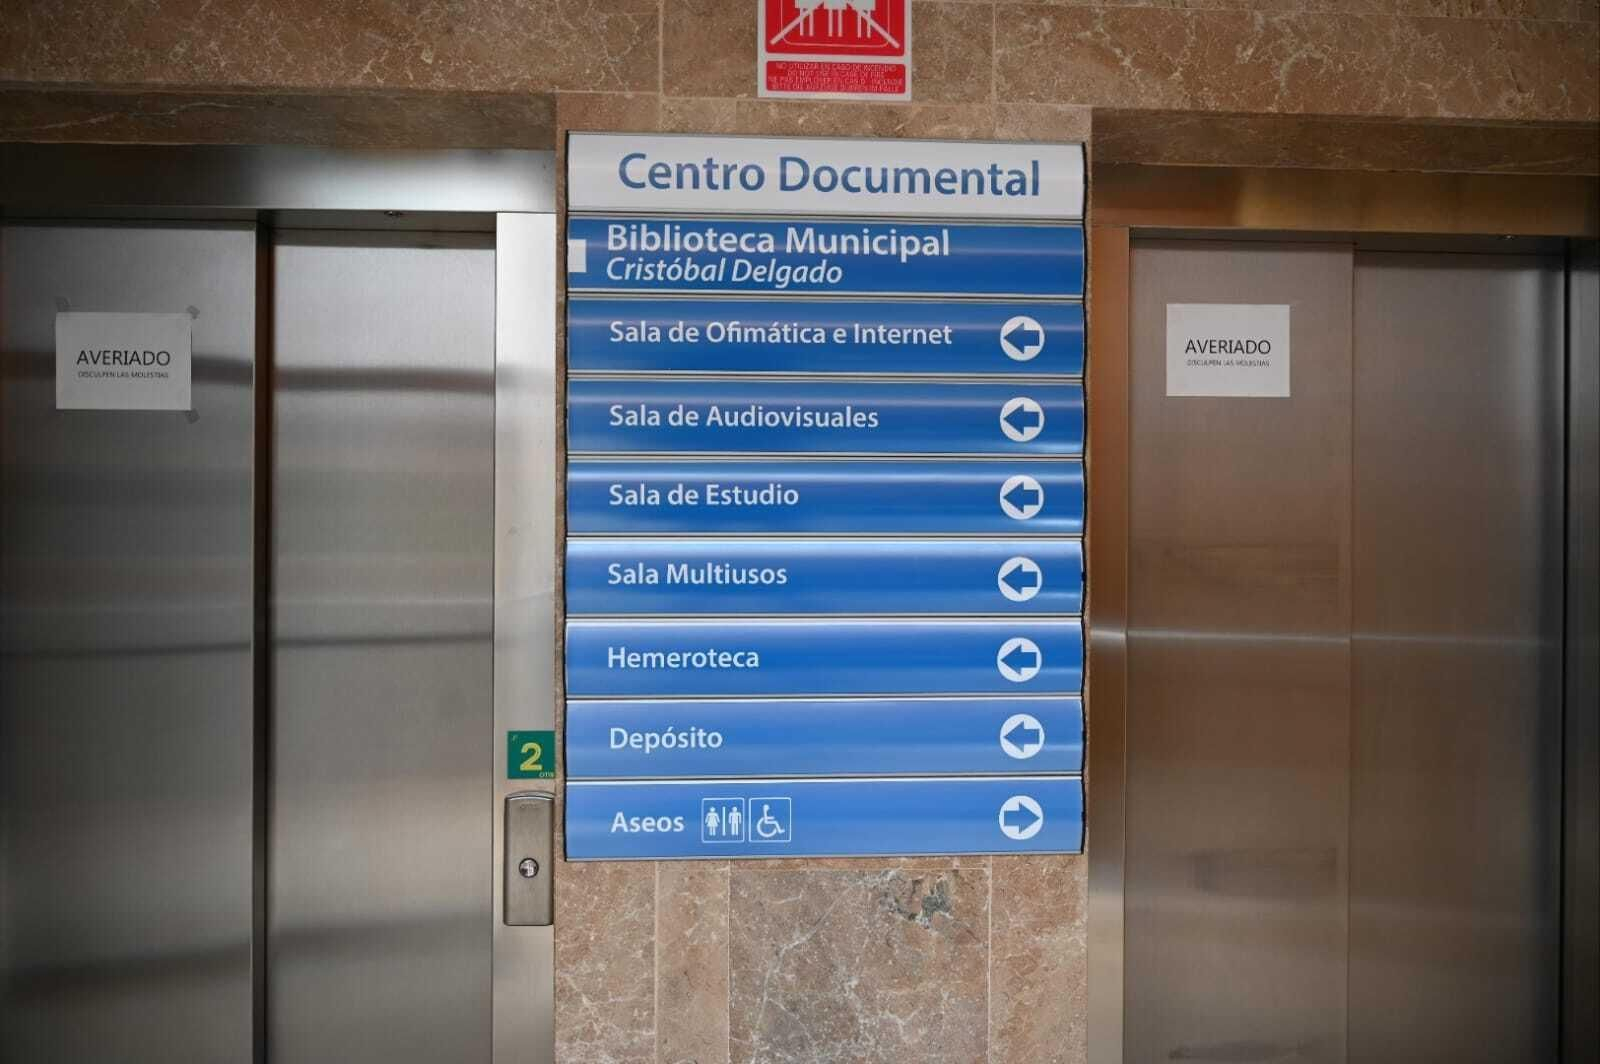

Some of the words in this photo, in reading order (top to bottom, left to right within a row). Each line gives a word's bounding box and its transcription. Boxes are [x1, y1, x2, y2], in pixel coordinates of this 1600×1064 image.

[619, 152, 765, 191] Centro
[779, 156, 1040, 197] Documental
[607, 224, 775, 255] Biblioteca
[786, 227, 949, 262] Municipal
[606, 256, 725, 284] Cristóbal
[731, 258, 843, 288] Delgado
[609, 320, 661, 343] Sala
[668, 320, 699, 343] de
[706, 321, 826, 345] Ofimática
[833, 328, 847, 345] e
[853, 323, 953, 346] Internet
[76, 350, 171, 366] AVERIADO
[1185, 339, 1271, 355] AVERIADO
[609, 404, 660, 427] Sala
[668, 404, 699, 427] de
[706, 404, 879, 428] Audiovisuales
[609, 483, 660, 506] Sala
[667, 483, 699, 506] de
[705, 483, 799, 506] Estudio
[608, 563, 659, 586] Sala
[665, 562, 788, 586] Multiusos
[607, 646, 760, 669] Hemeroteca
[609, 725, 723, 755] Depósito
[519, 742, 543, 771] 2
[610, 811, 685, 833] Aseos
